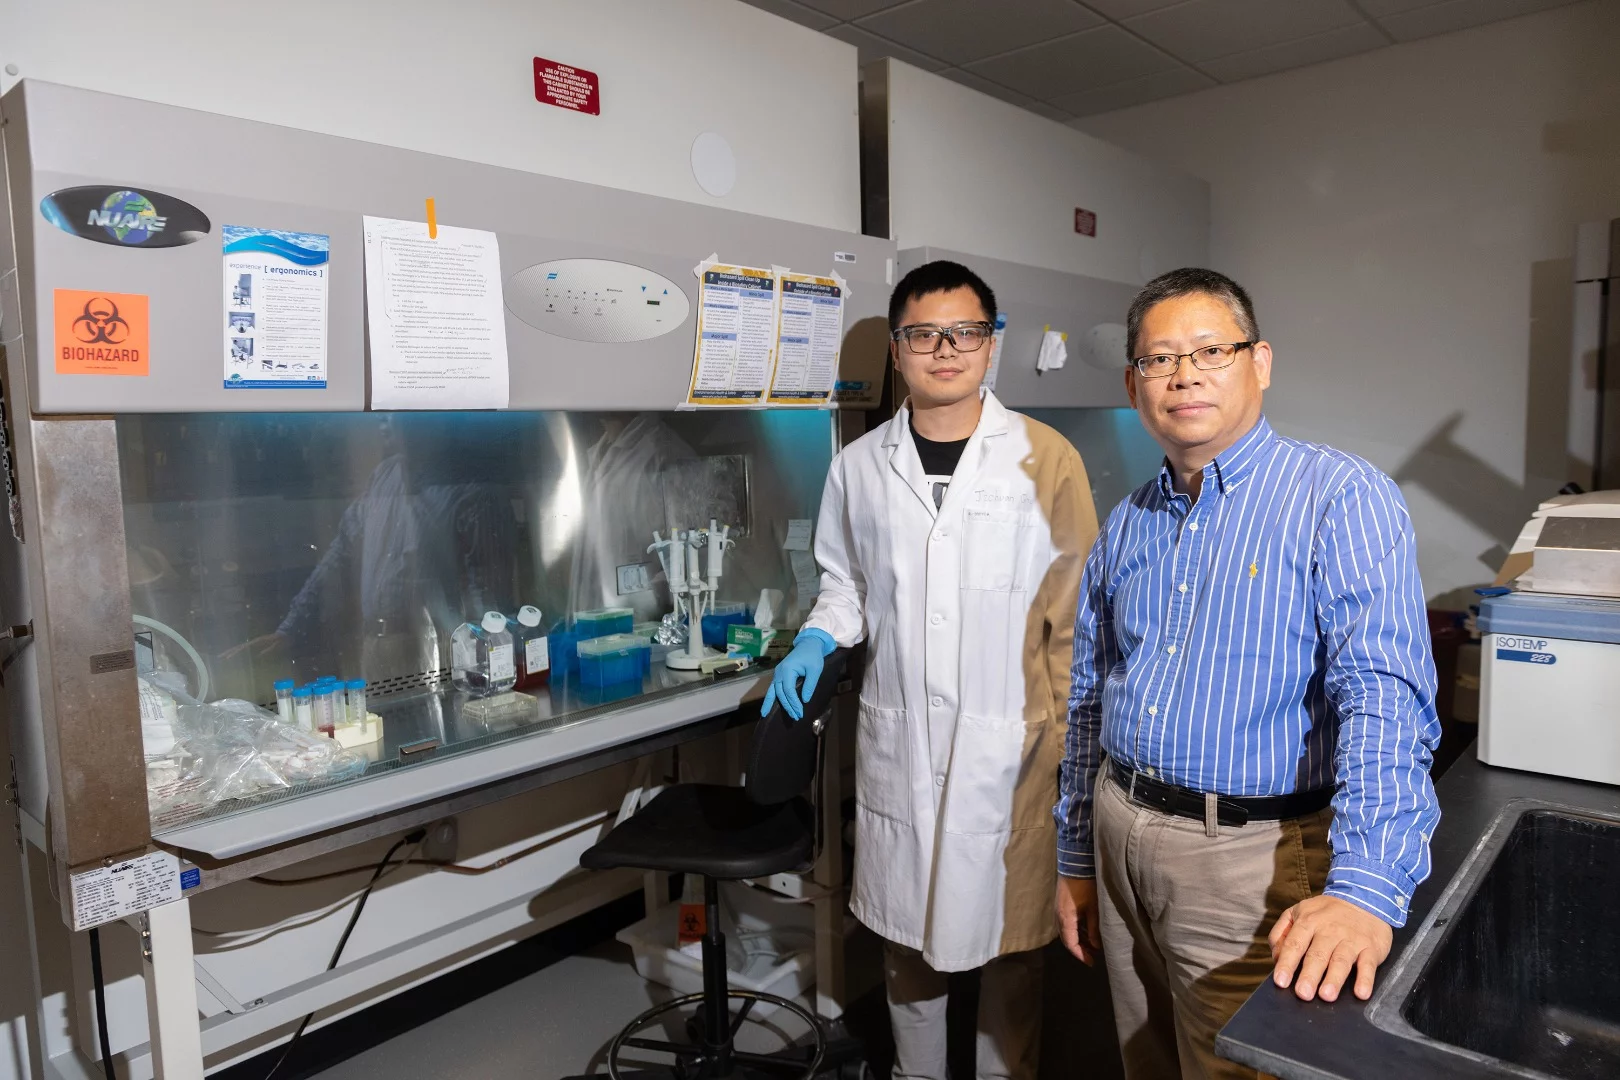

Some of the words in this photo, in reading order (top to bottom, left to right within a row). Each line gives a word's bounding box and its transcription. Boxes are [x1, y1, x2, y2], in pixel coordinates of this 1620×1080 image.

[557, 65, 575, 74] CAUTION
[87, 209, 168, 232] NUAIRE
[270, 267, 317, 277] ergonomics
[62, 346, 139, 362] BIOHAZARD
[1496, 637, 1547, 650] ISOTEMP
